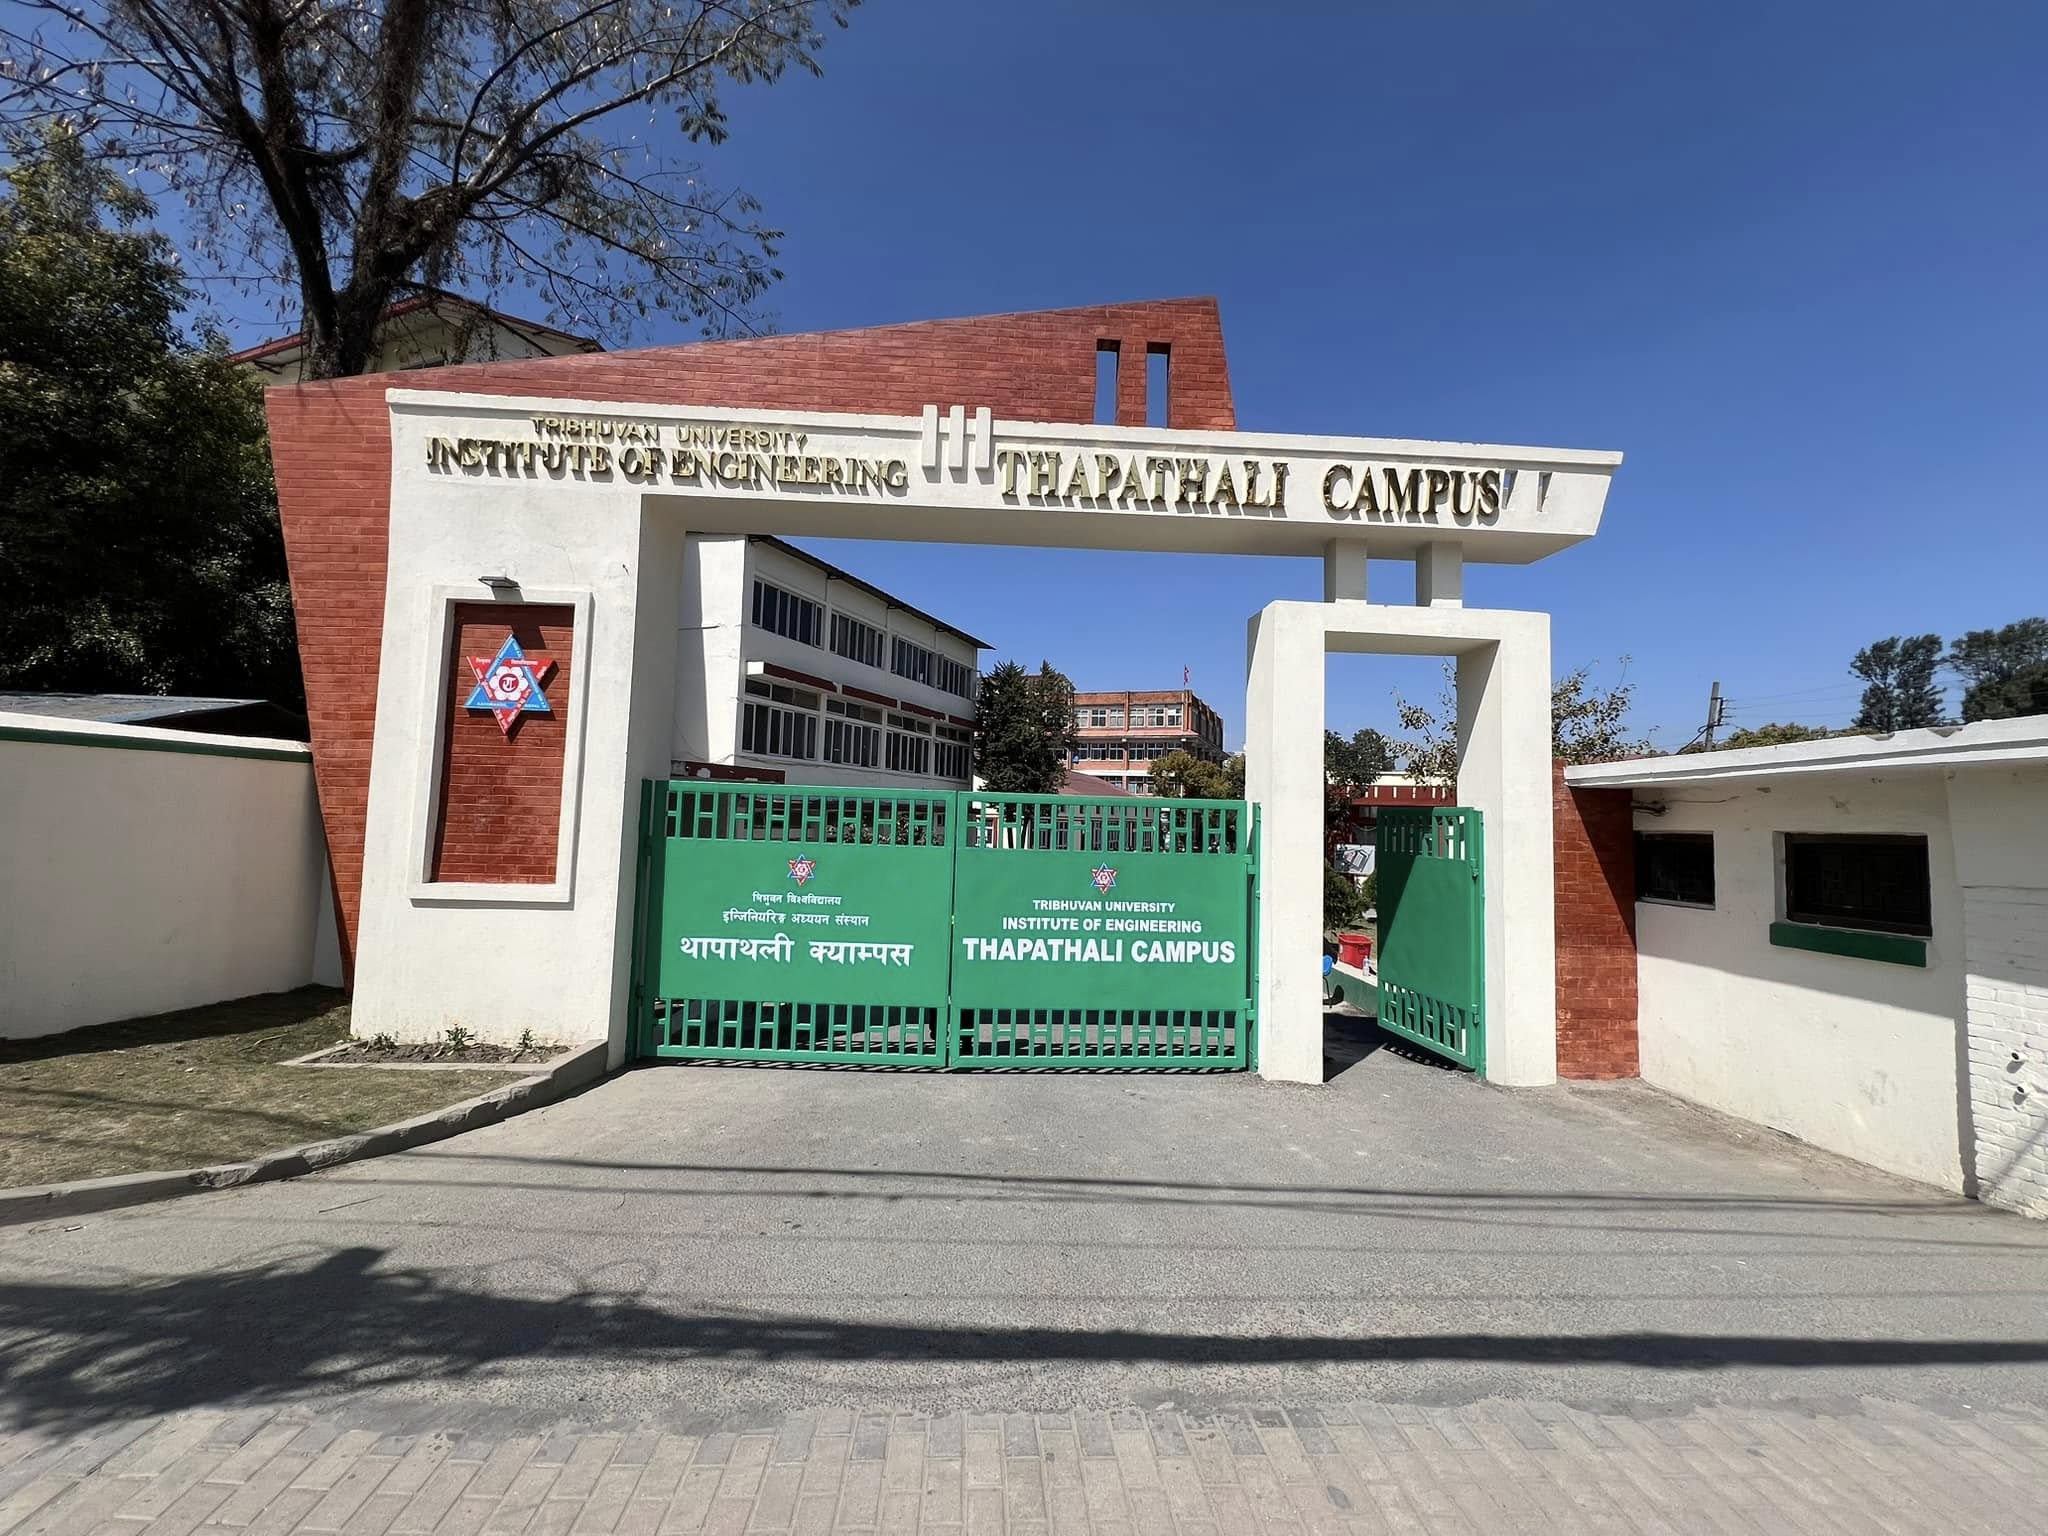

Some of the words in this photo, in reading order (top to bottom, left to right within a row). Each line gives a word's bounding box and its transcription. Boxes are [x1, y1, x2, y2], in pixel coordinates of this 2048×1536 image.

[530, 417, 660, 442] TRIBHUVAN
[675, 424, 808, 453] UNIVERSITY
[424, 436, 611, 474] INSTITUTE
[618, 446, 665, 477] OF
[670, 449, 909, 488] ENGINEERING
[997, 450, 1289, 508] THAPATHALI
[1321, 464, 1501, 516] CAMPUS
[786, 891, 842, 905] विश्वविद्यालय
[1032, 899, 1102, 911] TRIBHUVAN
[1105, 901, 1175, 913] UNIVERSITY
[791, 913, 830, 925] अध्ययन
[835, 913, 870, 926] संस्थान
[1002, 917, 1079, 931] INSTITUTE
[1082, 918, 1102, 931] OF
[1105, 918, 1202, 933] ENGINEERING
[680, 932, 795, 962] थापाथली
[808, 941, 914, 967] क्याम्पस
[962, 937, 1123, 962] THAPATHALI
[1131, 940, 1235, 964] CAMPUS
